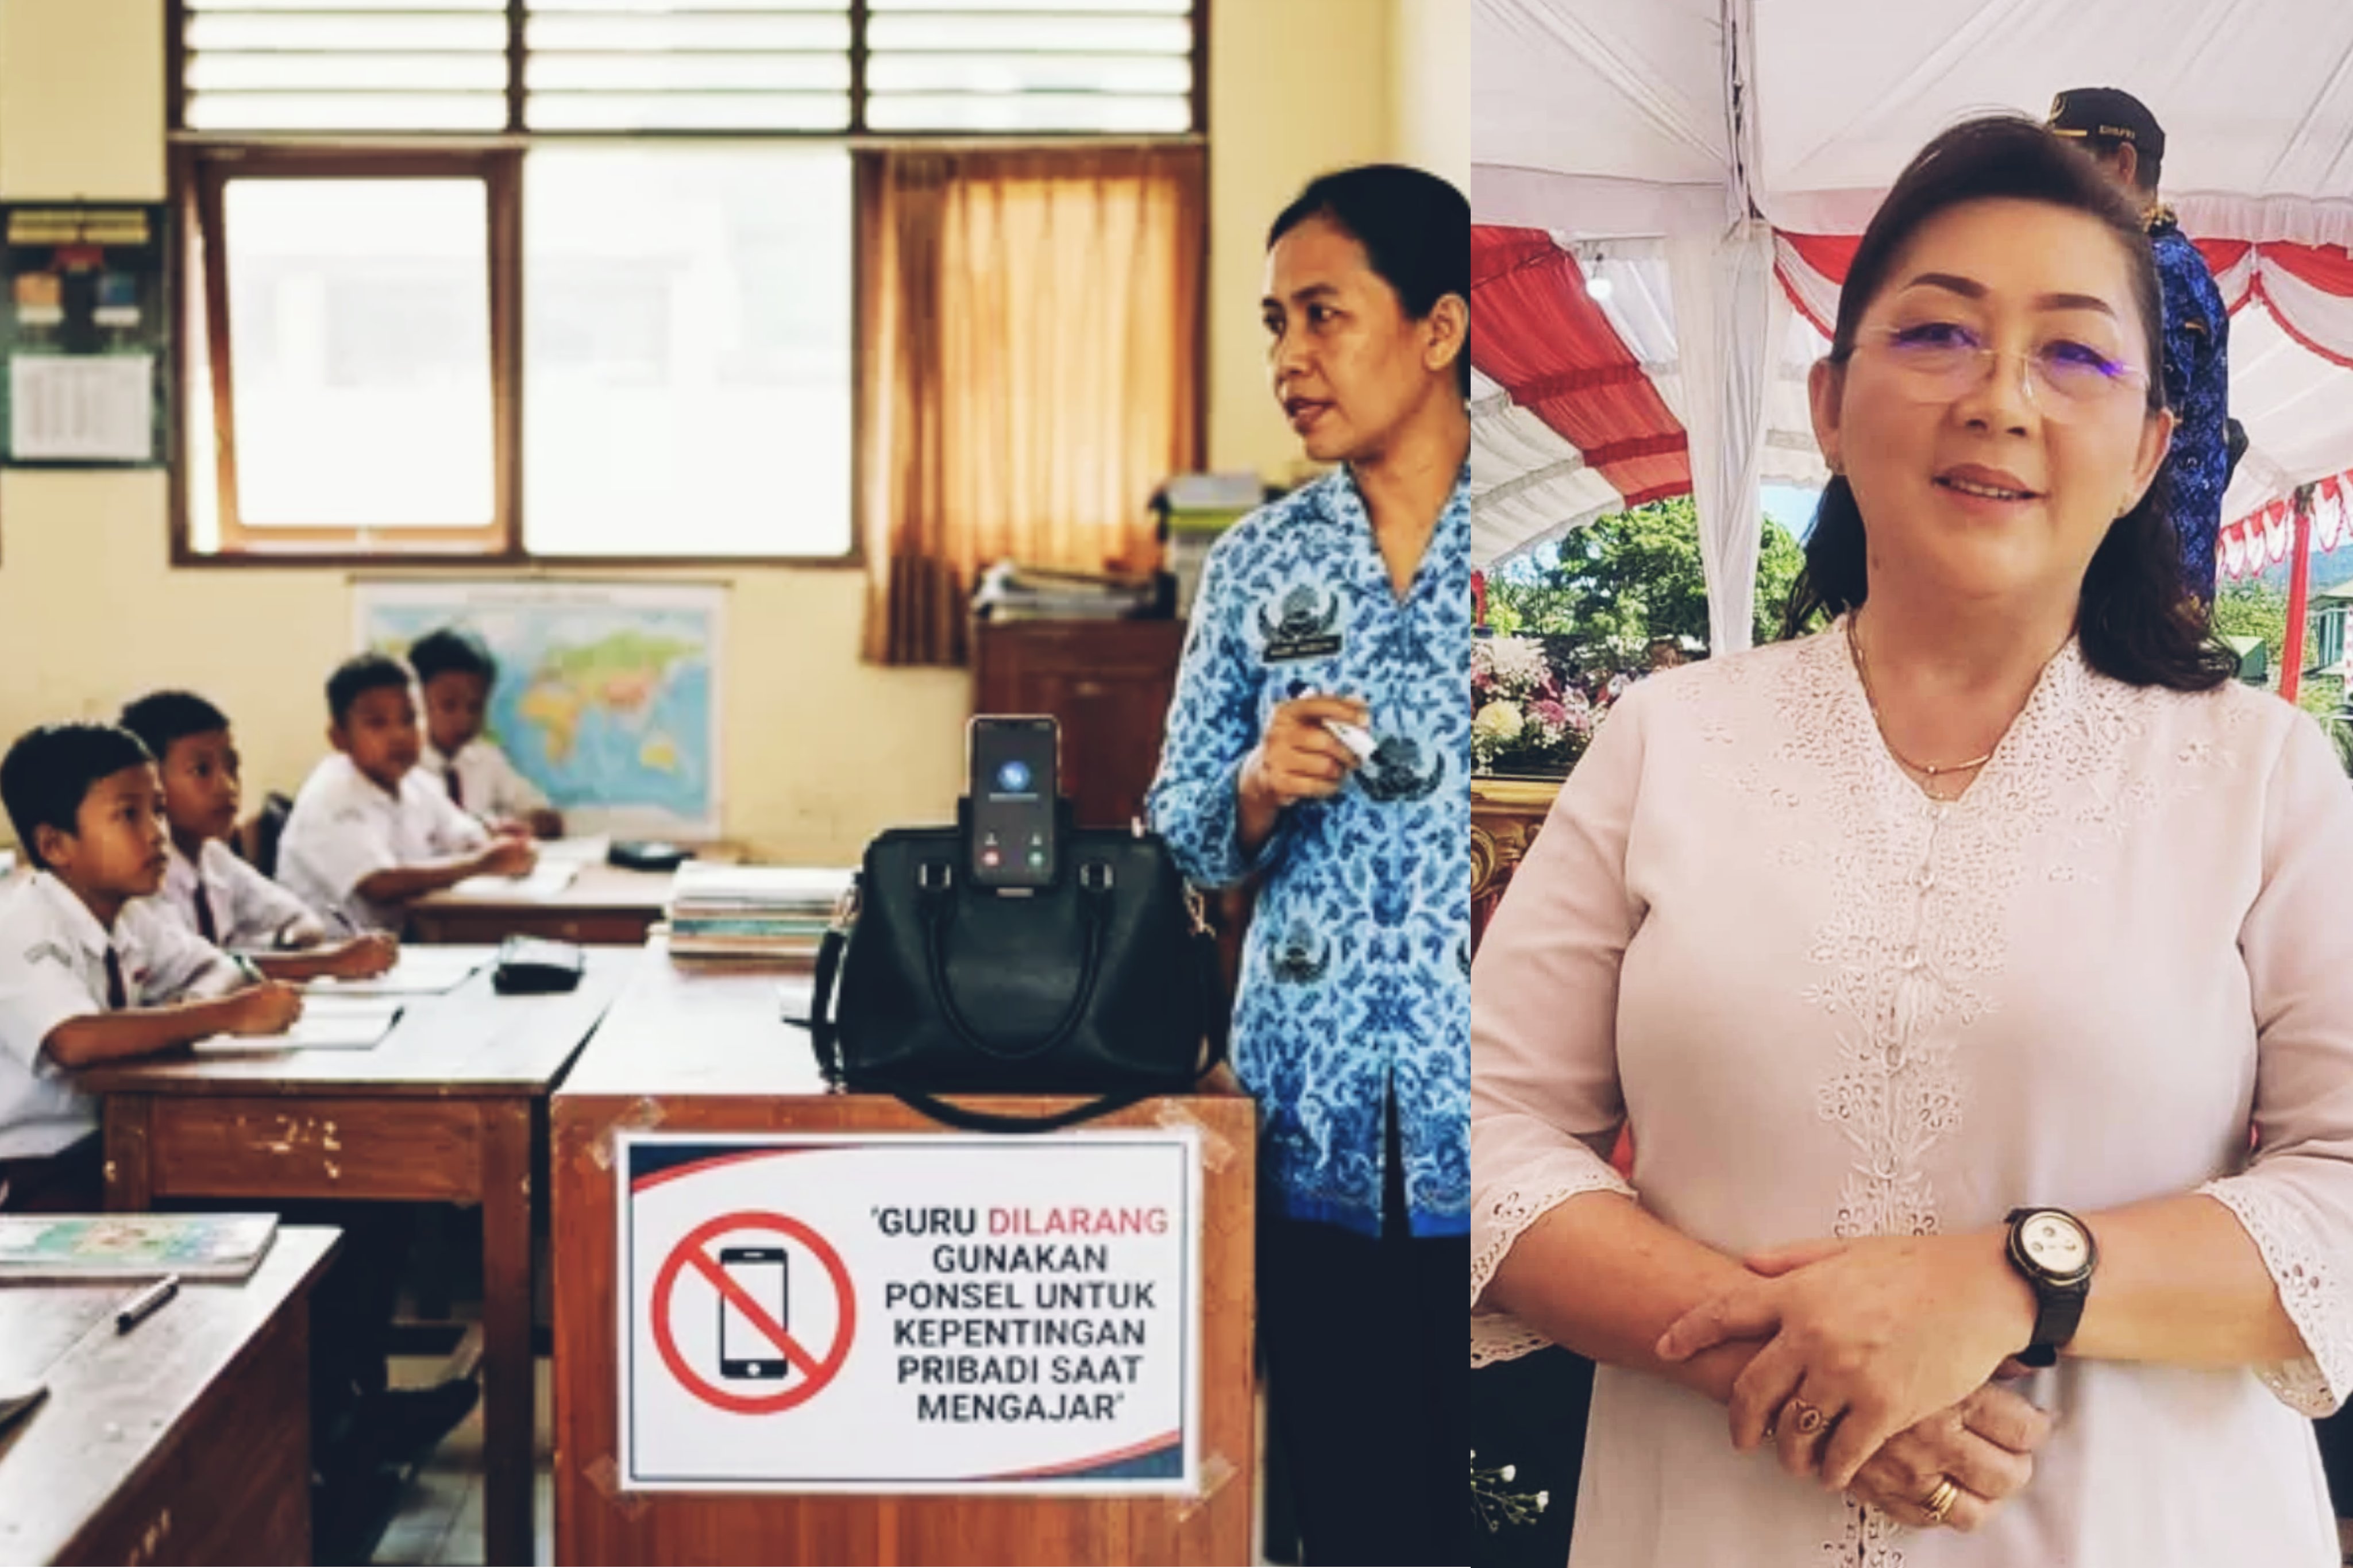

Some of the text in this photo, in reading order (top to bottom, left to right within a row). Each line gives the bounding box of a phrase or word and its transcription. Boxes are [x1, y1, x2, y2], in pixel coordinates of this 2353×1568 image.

[988, 1207, 1168, 1237] DILARANG
[932, 1243, 1108, 1273] GUNAKAN
[885, 1280, 1156, 1310] PONSEL UNTUK
[893, 1318, 1145, 1347] KEPENTINGAN
[897, 1355, 1144, 1385] PRIBADI SAAT
